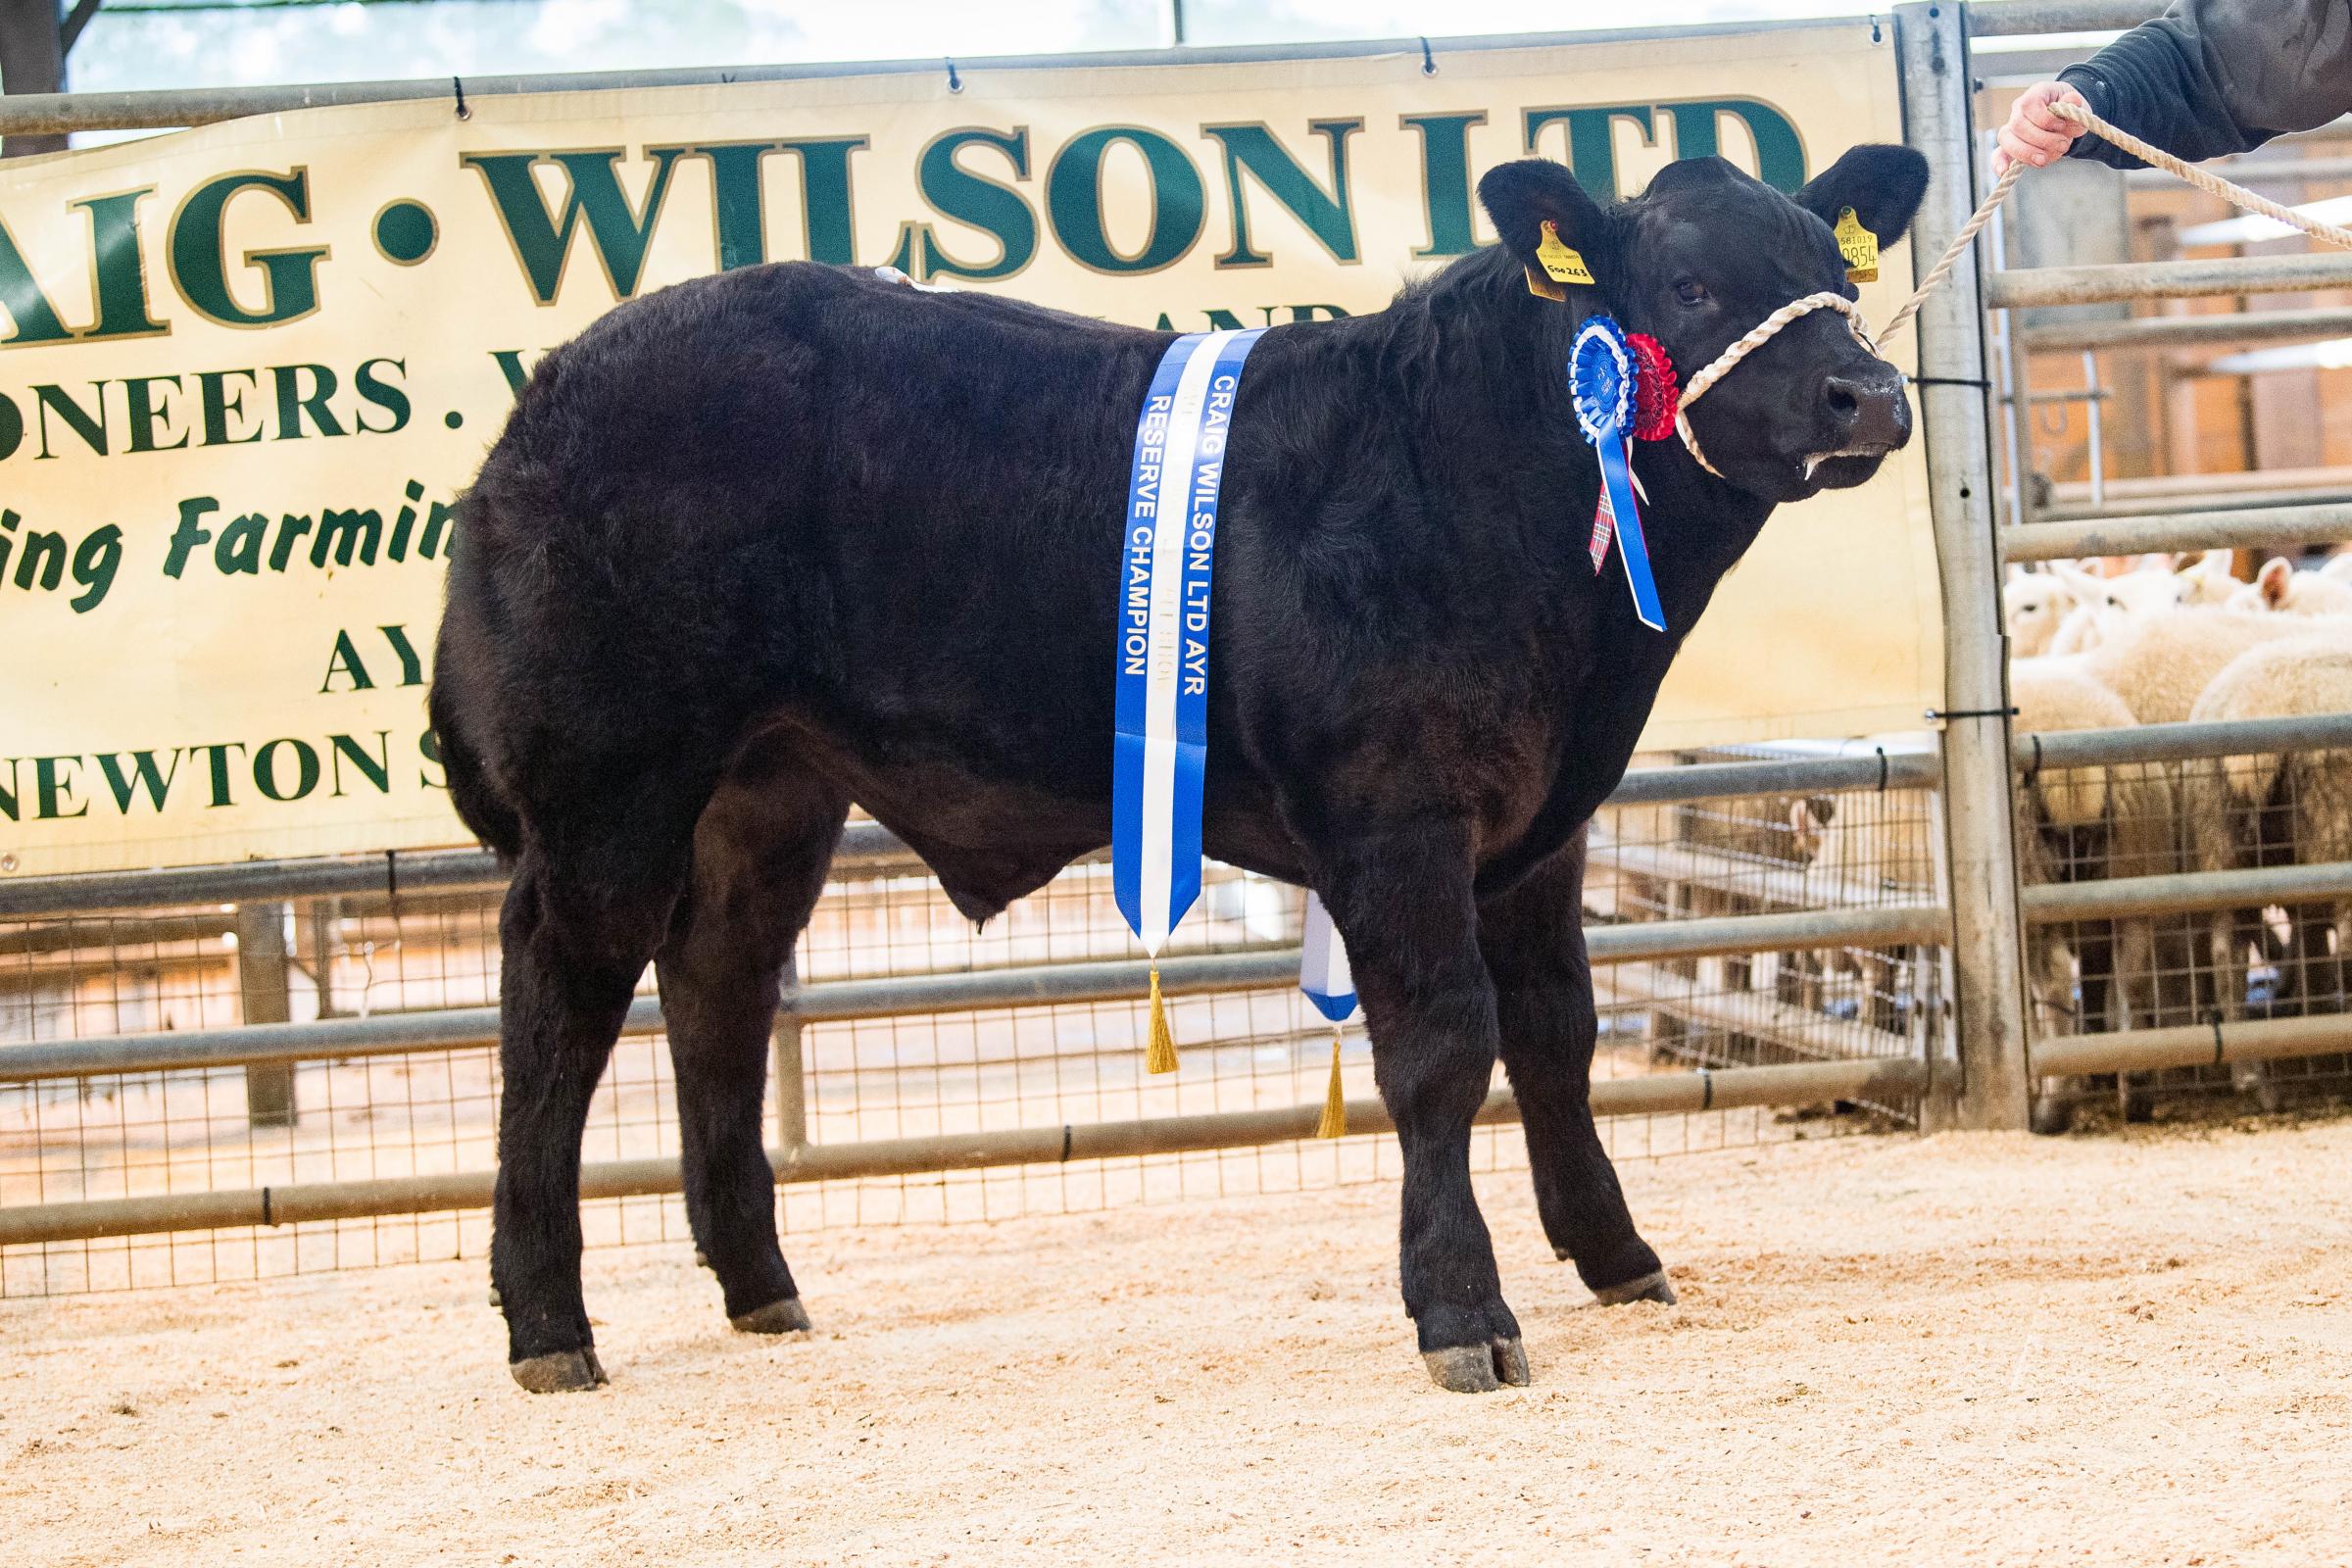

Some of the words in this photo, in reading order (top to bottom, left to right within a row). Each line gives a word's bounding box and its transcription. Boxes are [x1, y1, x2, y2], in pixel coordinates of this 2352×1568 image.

[460, 116, 1365, 307] WILSON
[1398, 94, 1809, 260] LTD
[0, 357, 412, 462] NEERS
[1134, 395, 1172, 518] RESERVE
[1201, 375, 1236, 455] CRAIG
[1189, 462, 1221, 570] WILSON
[1124, 526, 1153, 675] CHAMPION
[1186, 580, 1209, 632] LTD
[1184, 638, 1206, 696] AYR
